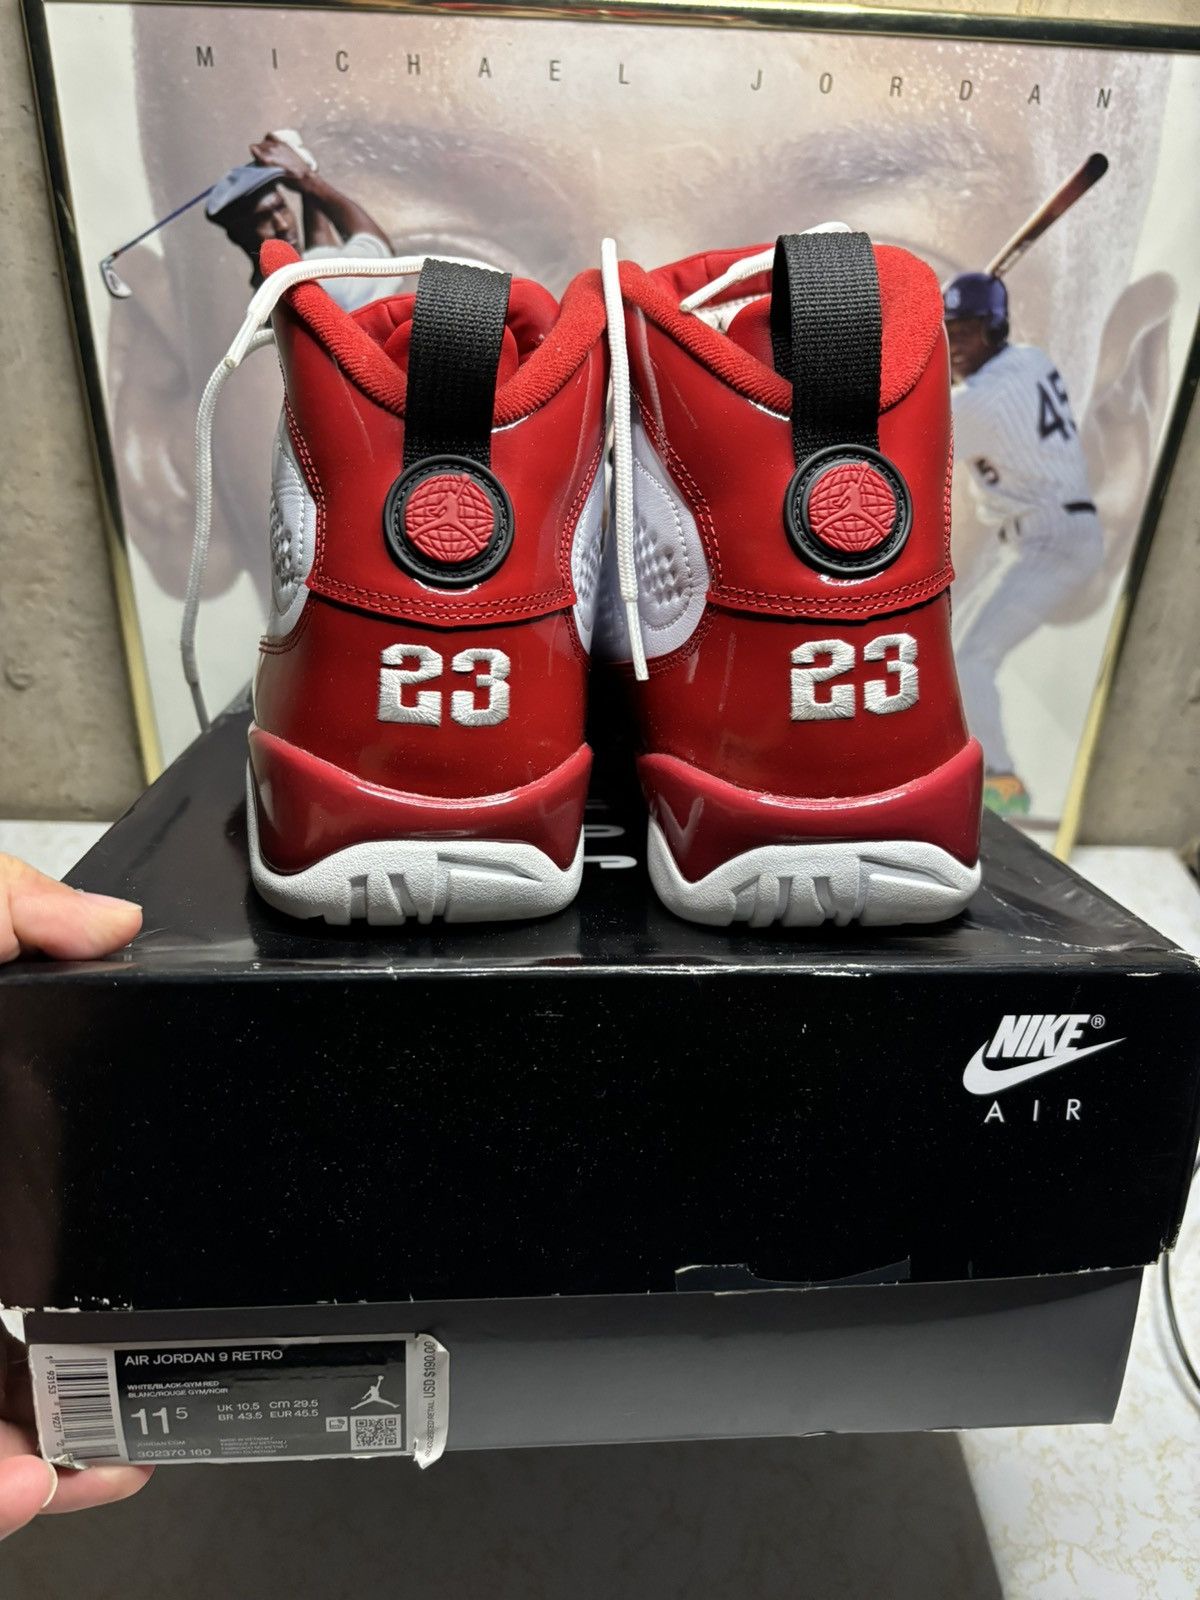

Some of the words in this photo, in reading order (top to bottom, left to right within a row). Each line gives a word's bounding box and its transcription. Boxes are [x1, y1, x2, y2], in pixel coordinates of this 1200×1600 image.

[196, 46, 630, 85] MICHAEL
[750, 69, 1112, 109] JORDAN
[378, 643, 511, 727] 23
[790, 632, 920, 721] 23
[986, 1014, 1090, 1058] NIKE
[983, 1099, 1081, 1123] AIR
[124, 1355, 150, 1366] AIR
[152, 1352, 215, 1365] JORDAN
[219, 1352, 228, 1362] 9
[232, 1349, 283, 1361] RETRO
[423, 1341, 436, 1378] $190.00
[423, 1379, 436, 1398] USD
[131, 1407, 170, 1435] 11
[175, 1407, 188, 1419] 5
[217, 1403, 233, 1412] UK
[237, 1402, 260, 1411] 10.5
[218, 1413, 234, 1421] BR
[237, 1411, 263, 1420] 43.5
[269, 1410, 292, 1418] EUR
